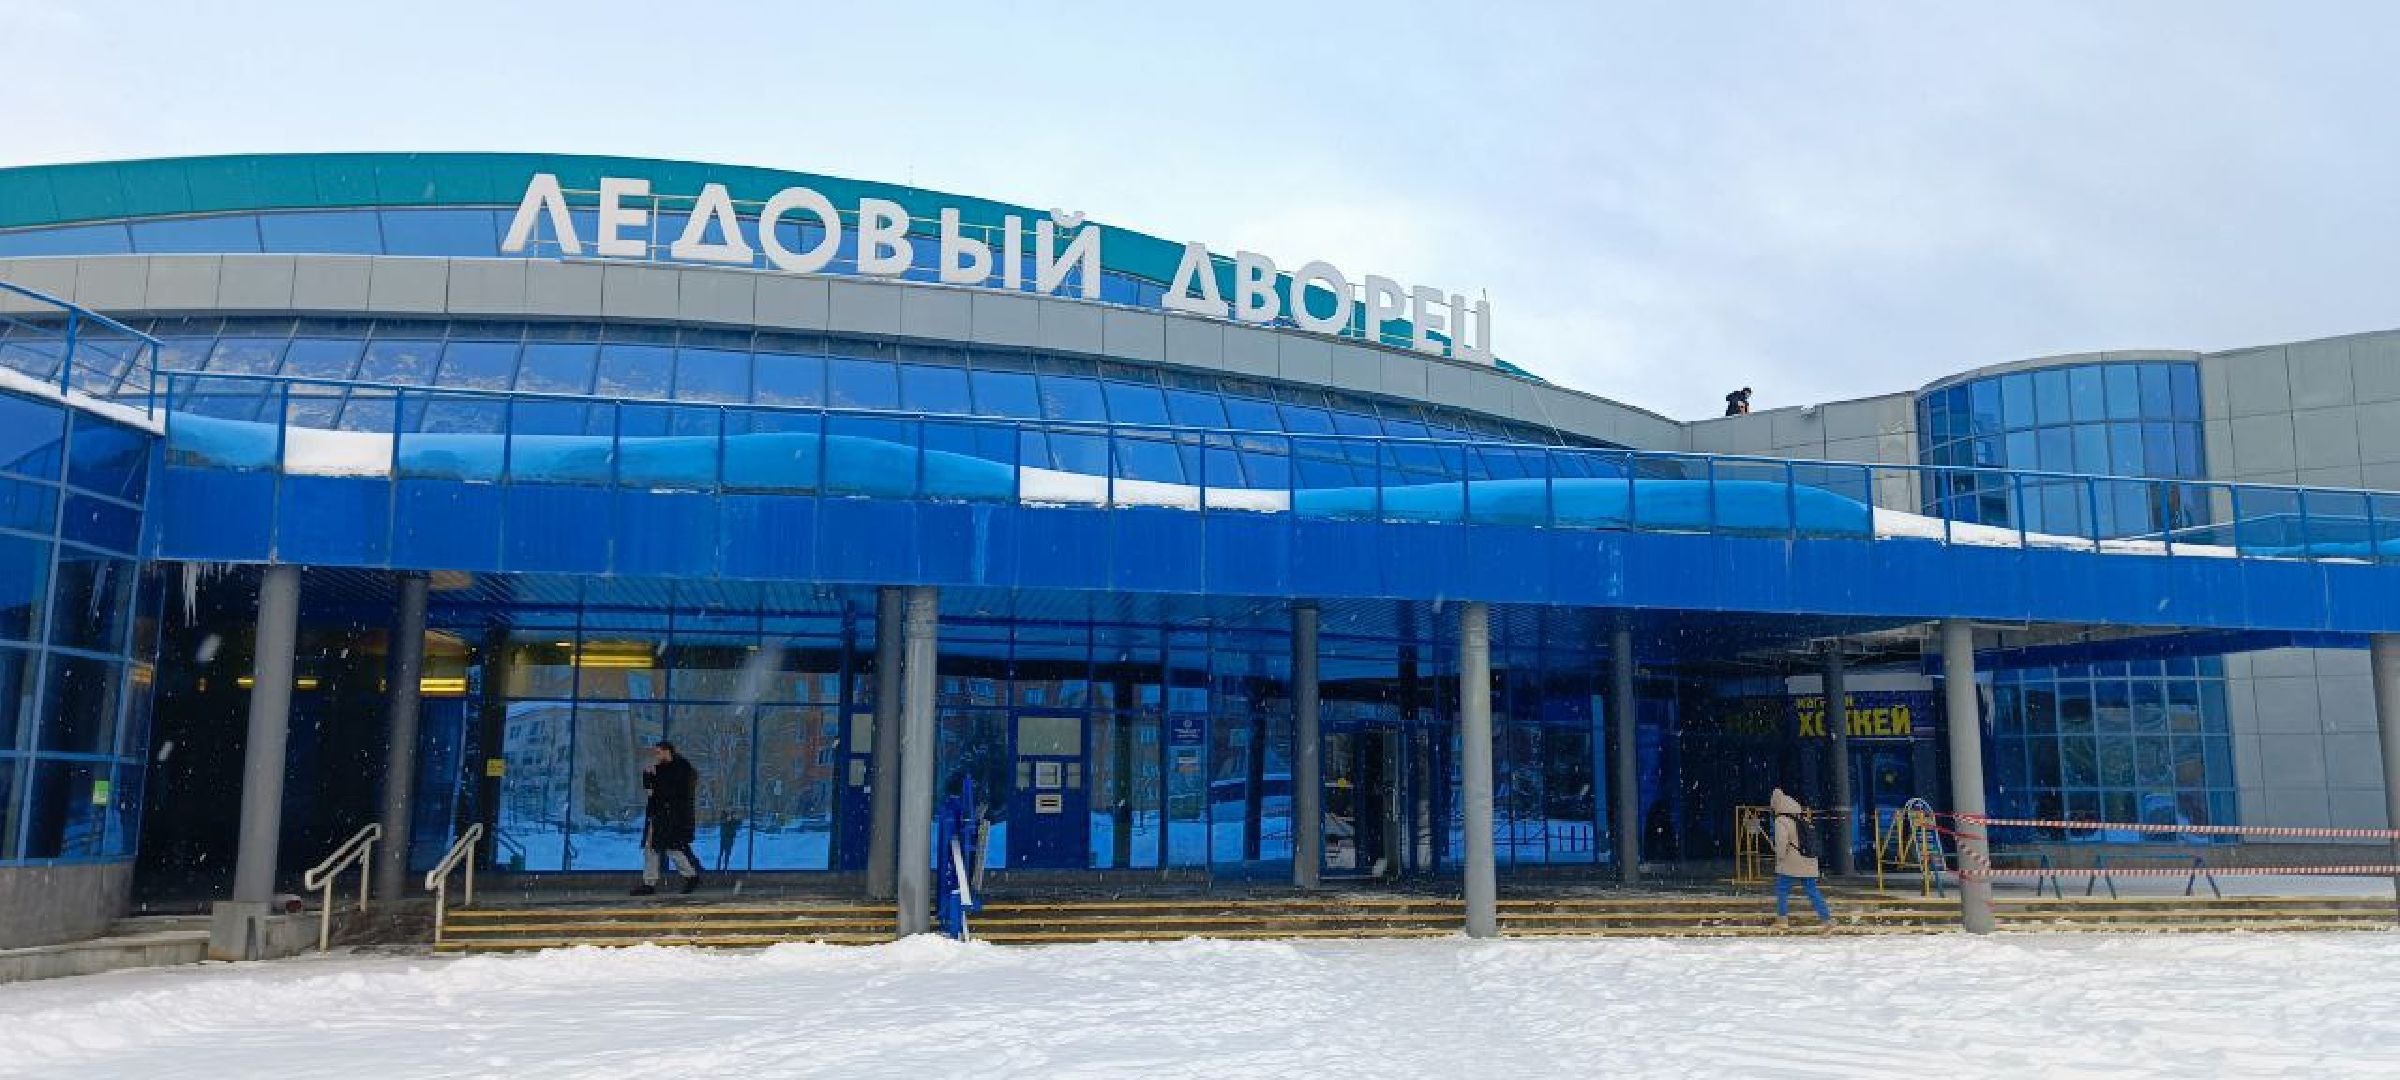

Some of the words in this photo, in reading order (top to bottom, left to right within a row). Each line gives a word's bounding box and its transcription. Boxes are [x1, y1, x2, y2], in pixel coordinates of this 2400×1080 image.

[501, 173, 1100, 300] ЛЕДОВЫЙ
[1161, 241, 1495, 367] ДВОРЕЦ
[1797, 695, 1854, 709] МАГН
